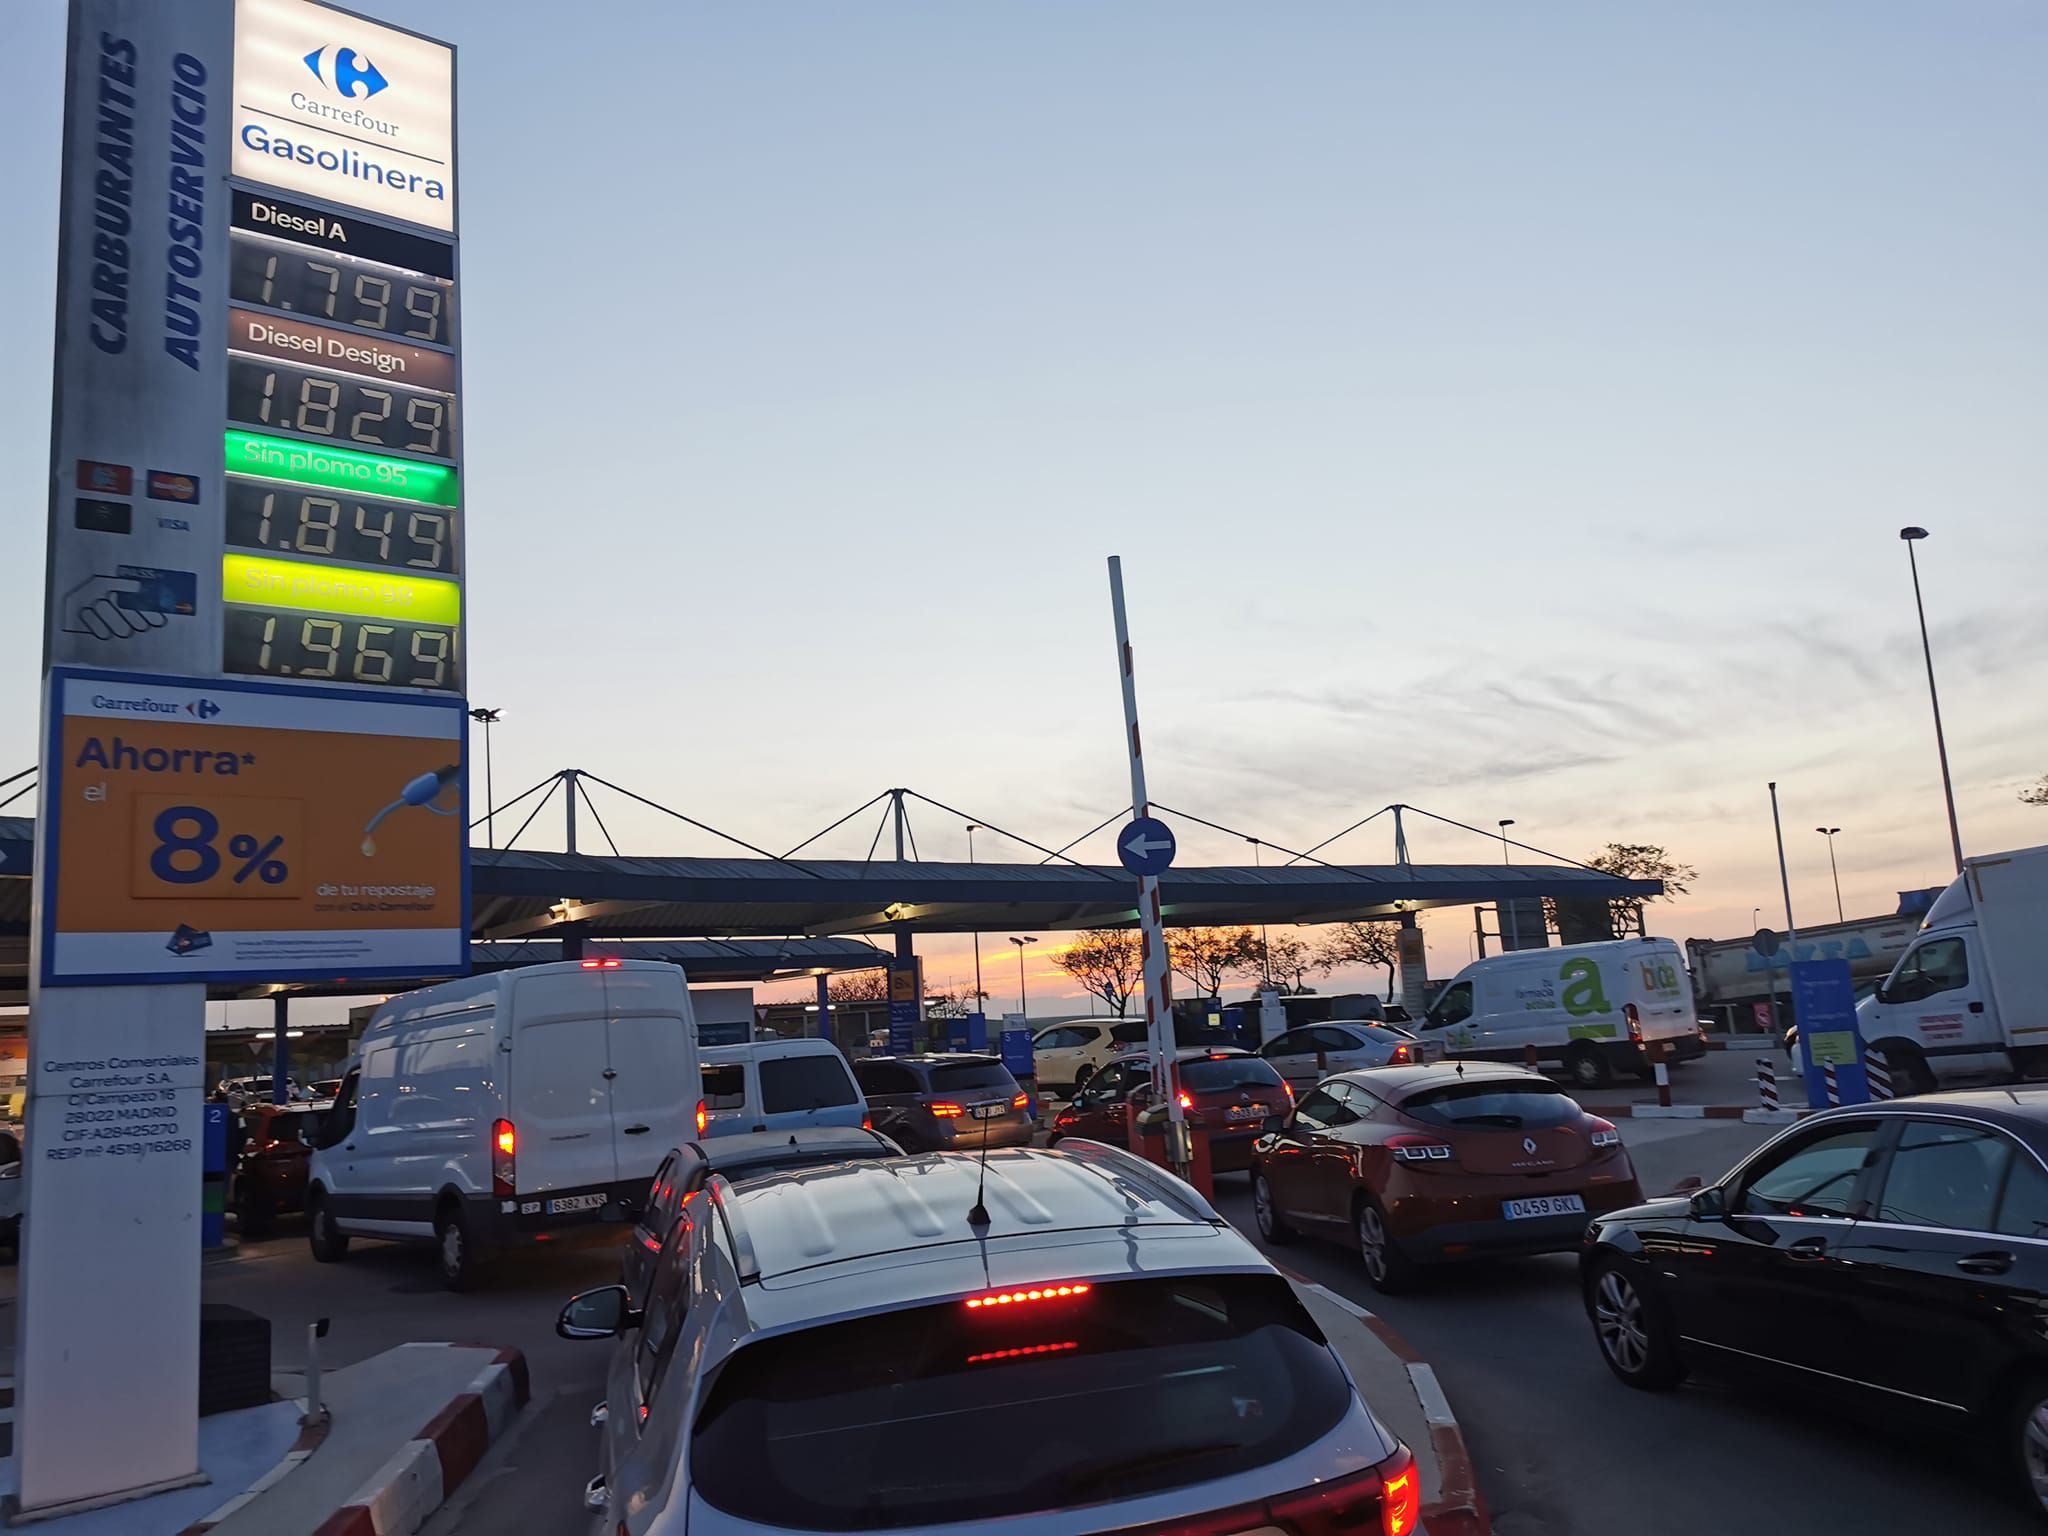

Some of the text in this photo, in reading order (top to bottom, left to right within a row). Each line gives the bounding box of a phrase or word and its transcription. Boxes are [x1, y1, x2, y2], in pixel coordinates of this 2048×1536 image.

[290, 92, 400, 138] Carrefour
[241, 124, 444, 201] Gasolinera
[90, 32, 138, 355] CARBURANTES
[164, 52, 208, 371] AUTOSERVICIO
[251, 202, 347, 243] Diesel A
[262, 255, 442, 341] 1.799
[248, 322, 406, 374] Diesel Design
[259, 372, 443, 454] 1.829
[244, 442, 408, 486] Sin plomo 95
[258, 493, 445, 569] 1.849
[245, 568, 288, 591] Sin
[291, 572, 376, 604] plomo
[258, 616, 449, 687] 1.969
[92, 695, 179, 715] Carrefour
[83, 782, 107, 802] el
[316, 883, 435, 900] de tu repostaje
[44, 1053, 200, 1073] Centros Comerciales
[70, 1074, 144, 1089] Carrefour
[64, 1106, 178, 1125] 28022 MADRID
[210, 1109, 222, 1123] 2
[1513, 1199, 1550, 1217] 0459
